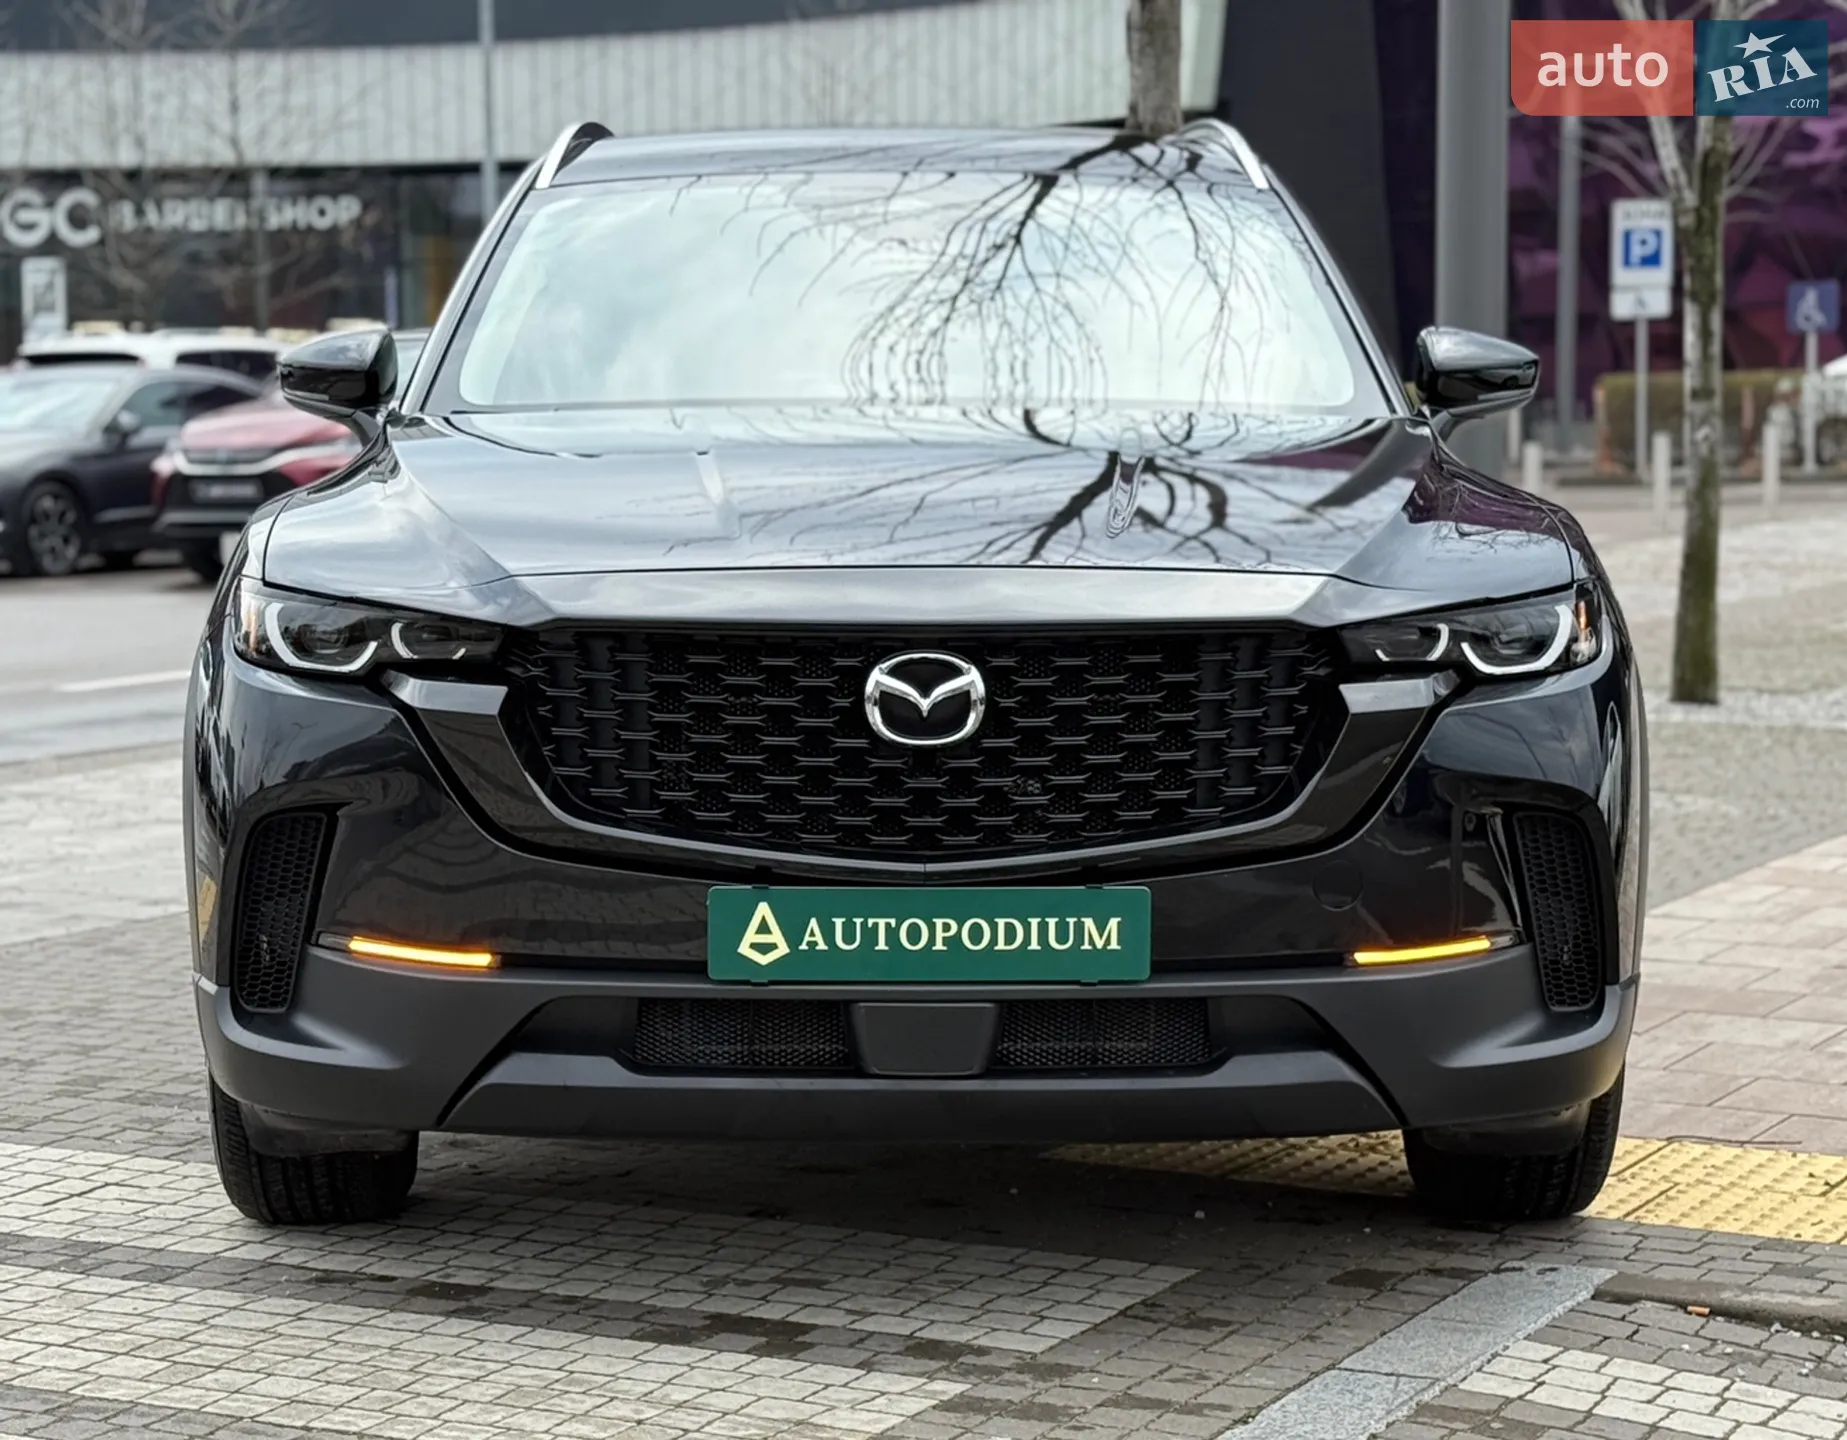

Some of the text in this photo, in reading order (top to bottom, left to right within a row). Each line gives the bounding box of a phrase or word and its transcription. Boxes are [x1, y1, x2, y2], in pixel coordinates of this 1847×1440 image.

[0, 187, 103, 249] GC
[263, 194, 362, 232] SHOP
[1628, 228, 1659, 266] P
[798, 917, 1122, 951] AUTOPODIUM
